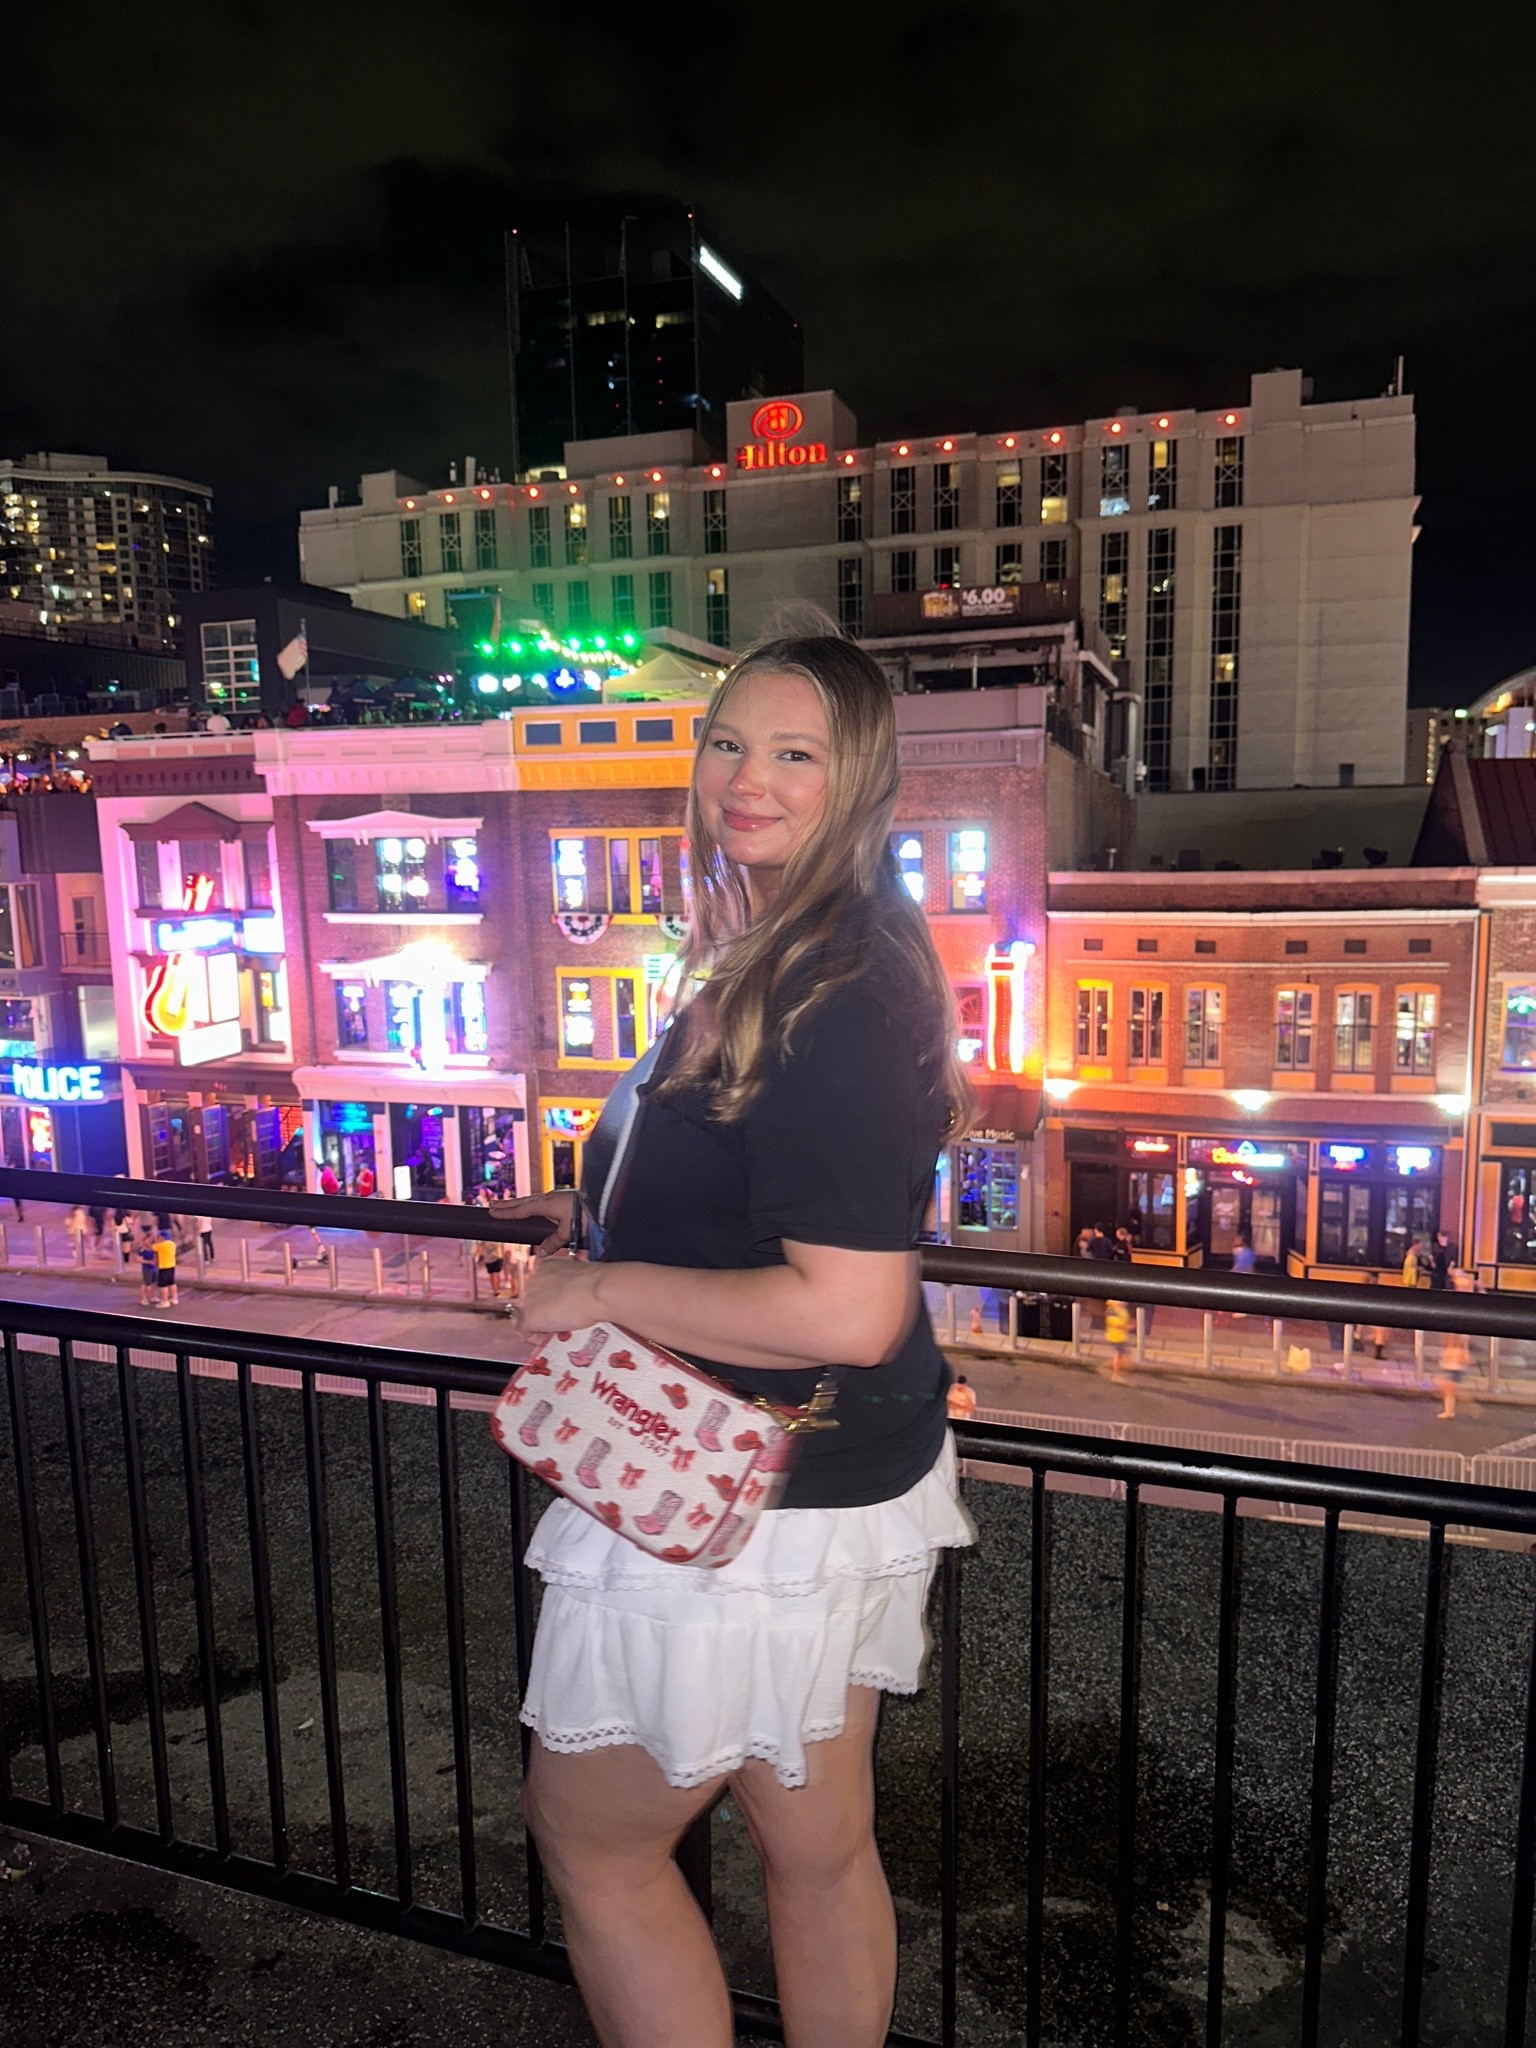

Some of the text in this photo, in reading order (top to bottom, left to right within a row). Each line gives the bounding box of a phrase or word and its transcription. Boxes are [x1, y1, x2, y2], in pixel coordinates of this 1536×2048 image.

[736, 440, 827, 470] Hilton
[962, 587, 1006, 605] $6.00
[985, 1129, 1015, 1140] Music
[590, 1370, 681, 1446] Wrangler
